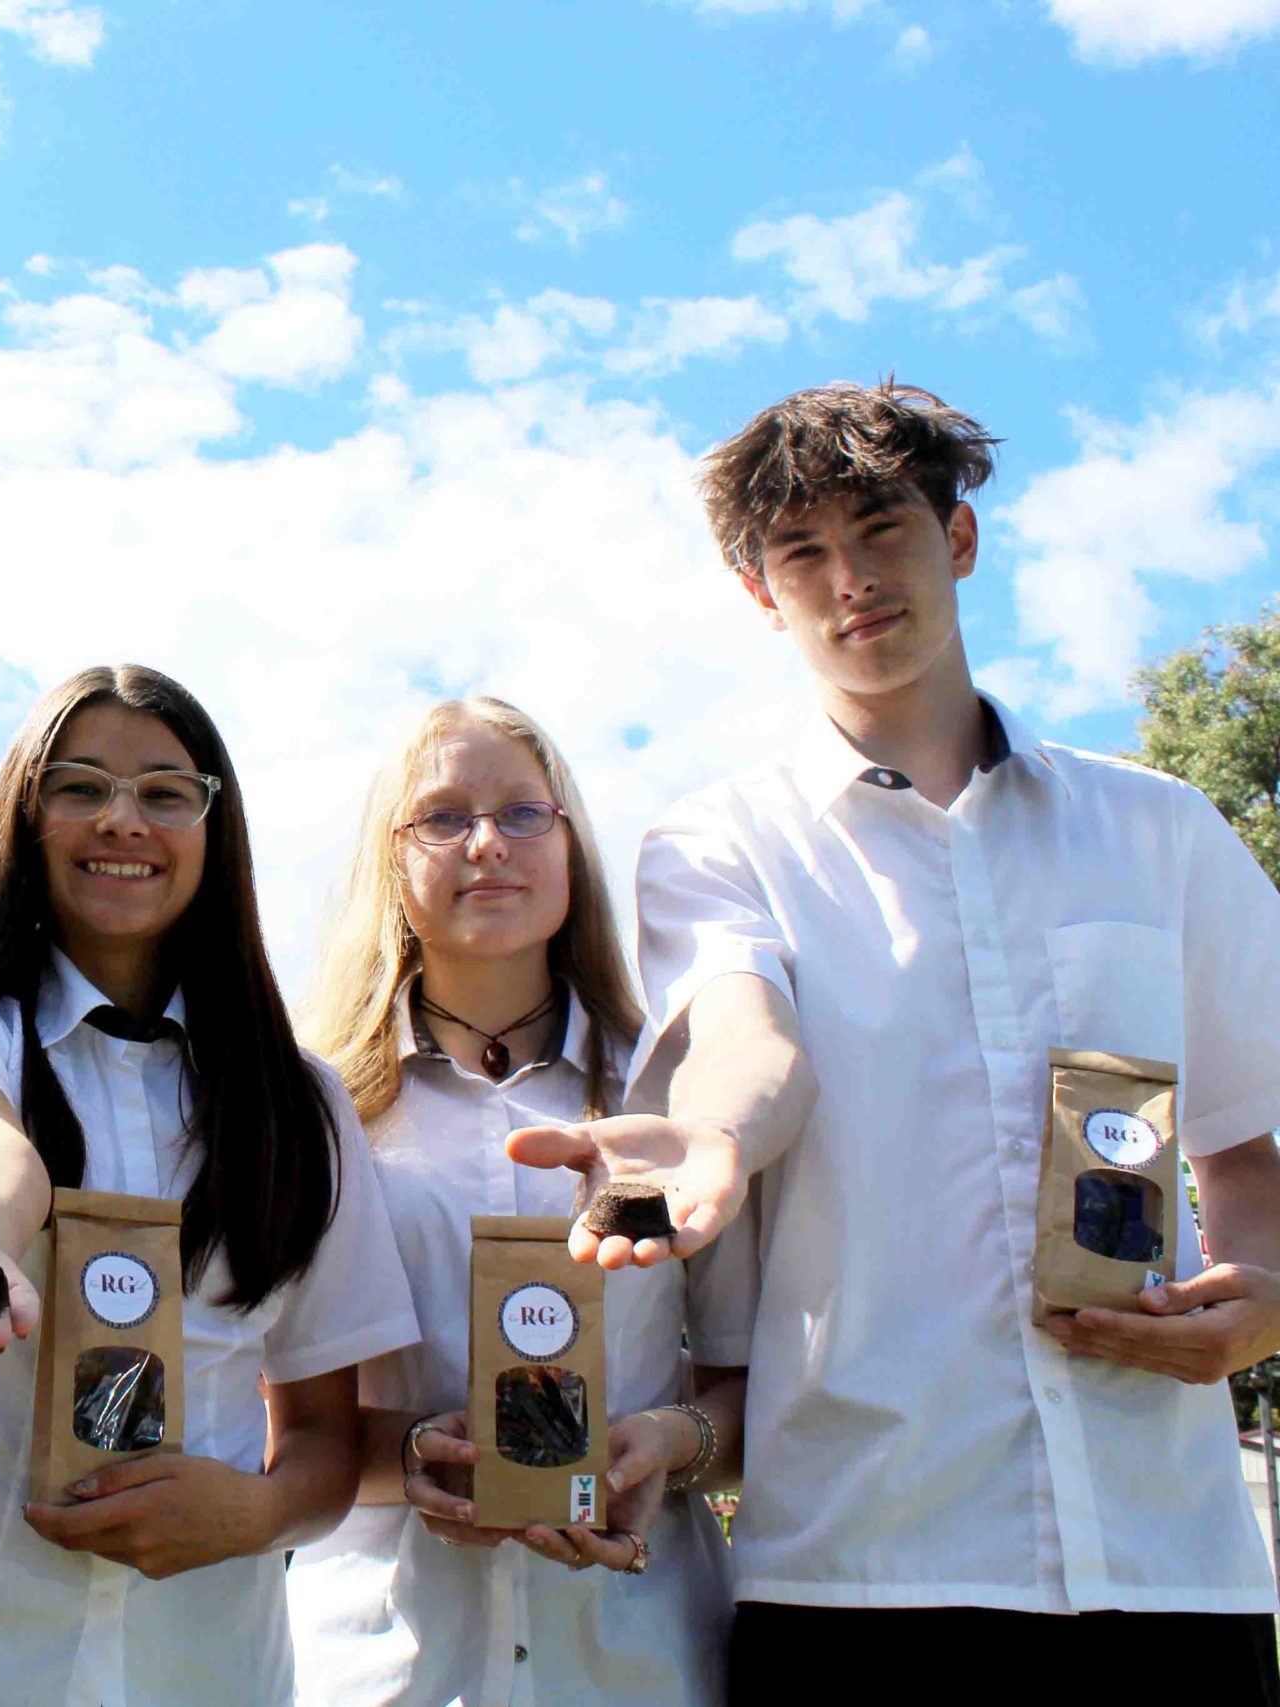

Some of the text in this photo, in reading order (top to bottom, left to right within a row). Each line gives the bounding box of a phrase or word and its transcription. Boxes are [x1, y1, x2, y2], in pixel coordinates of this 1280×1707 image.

[1104, 1125, 1138, 1143] RG
[101, 1273, 136, 1294] RG
[520, 1306, 555, 1326] RG
